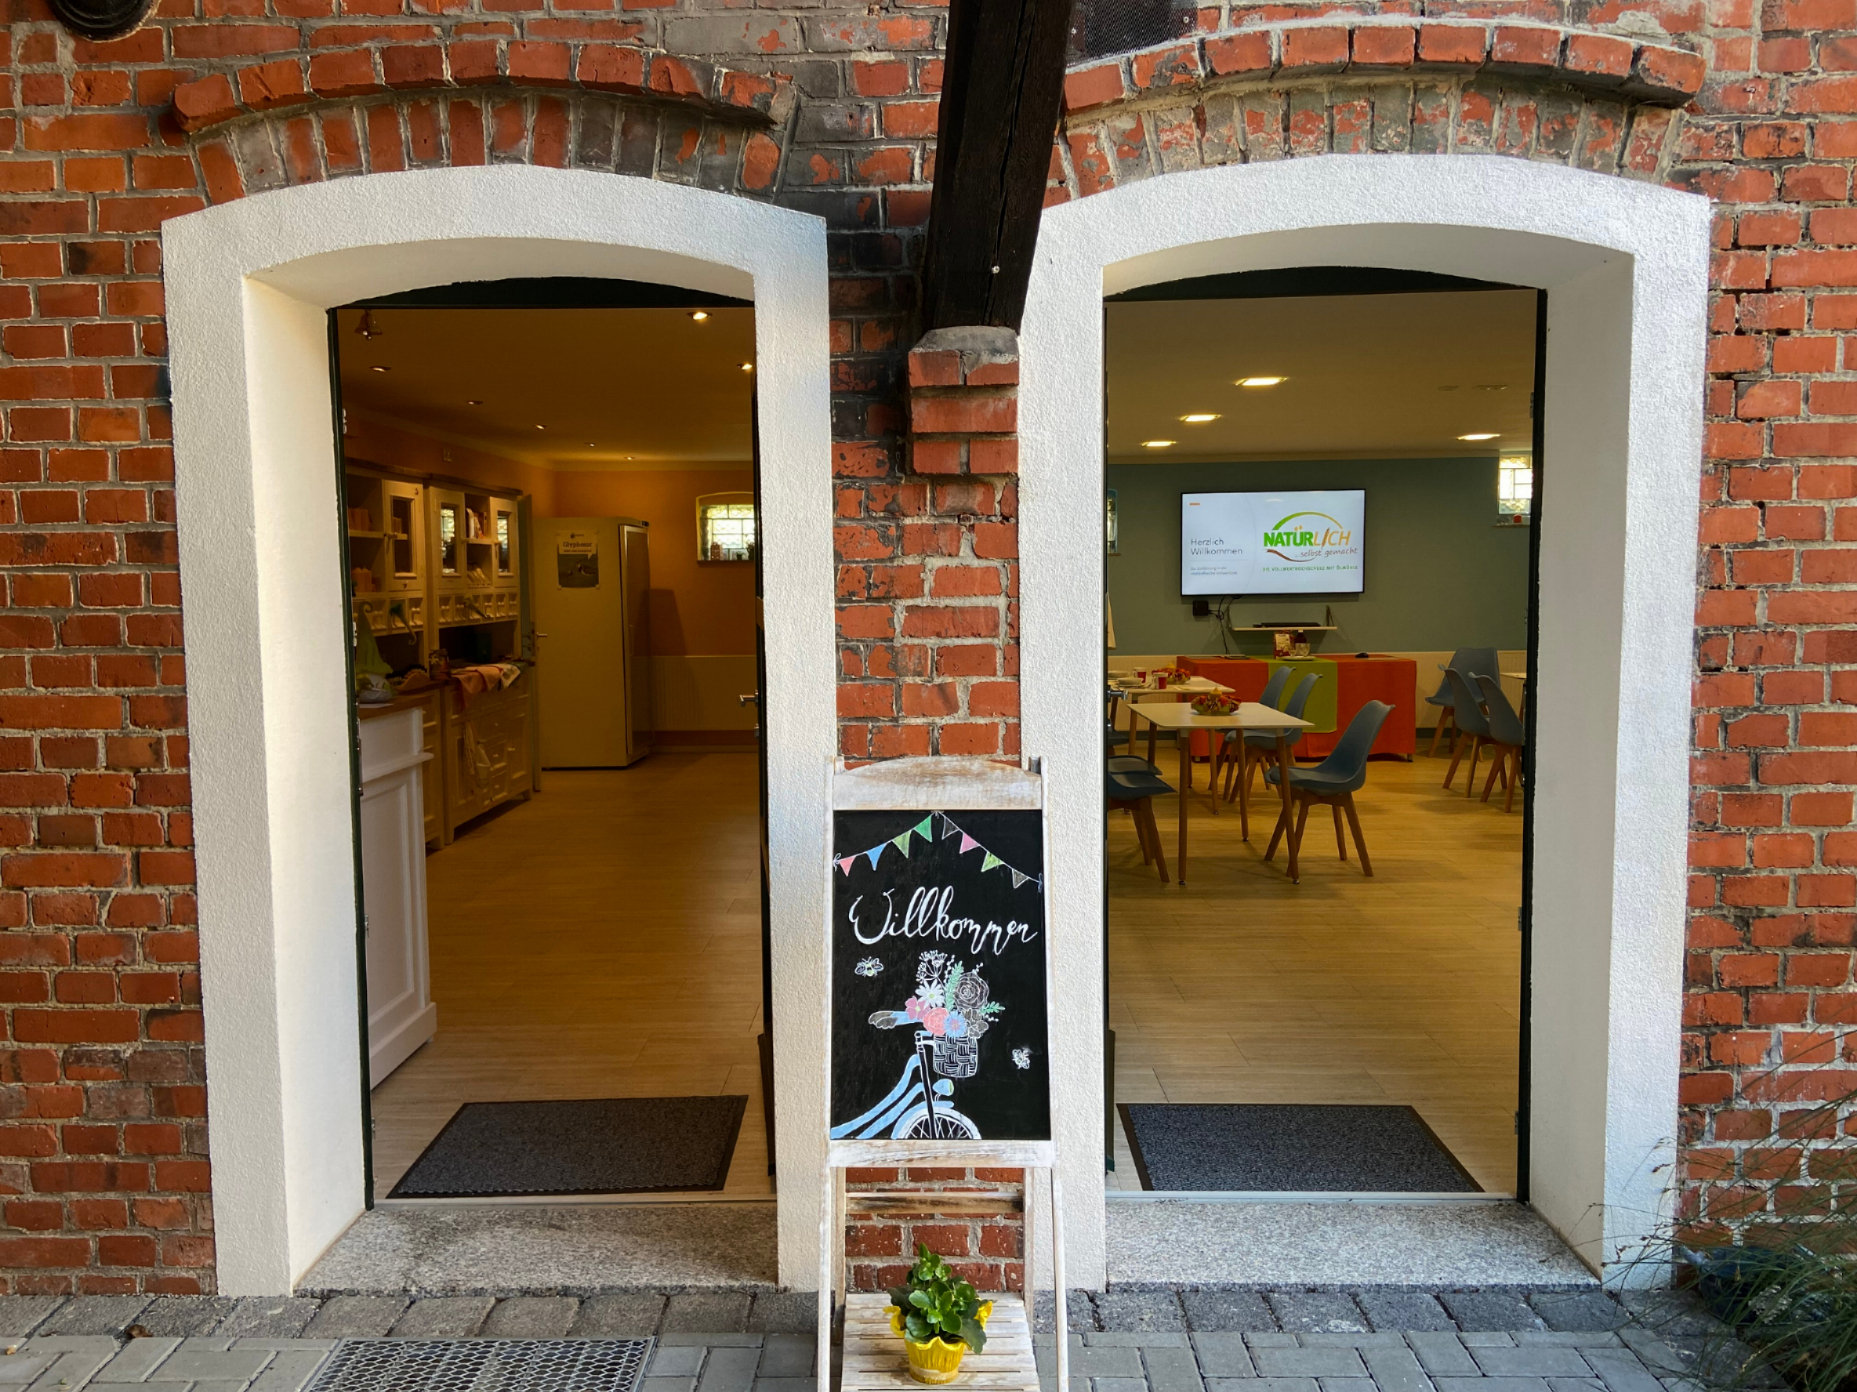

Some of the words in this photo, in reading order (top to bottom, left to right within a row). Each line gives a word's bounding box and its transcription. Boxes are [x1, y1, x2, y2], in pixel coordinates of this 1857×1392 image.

[1263, 525, 1351, 547] NATÜRLICH
[1190, 538, 1224, 546] Herzlich
[1190, 547, 1243, 555] Willkommen
[1324, 547, 1358, 558] gemacht
[848, 885, 1038, 956] Willkommen
